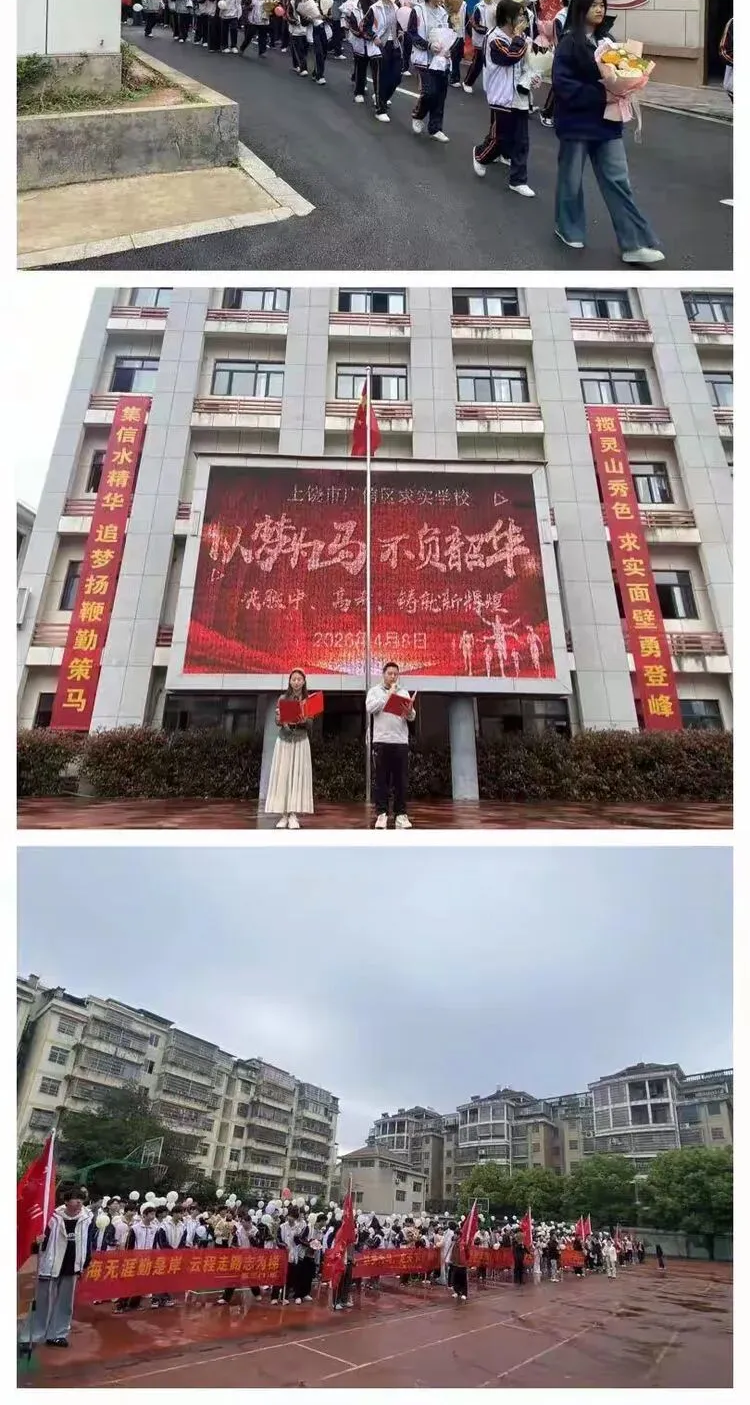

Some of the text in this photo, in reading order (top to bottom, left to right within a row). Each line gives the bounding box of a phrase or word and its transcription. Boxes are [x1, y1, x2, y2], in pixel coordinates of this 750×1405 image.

[62, 406, 143, 713] 集信水精华 追梦扬鞭勤策马
[378, 517, 531, 578] 不负韶华
[595, 416, 675, 718] 揽灵山秀色 求实面壁勇登峰
